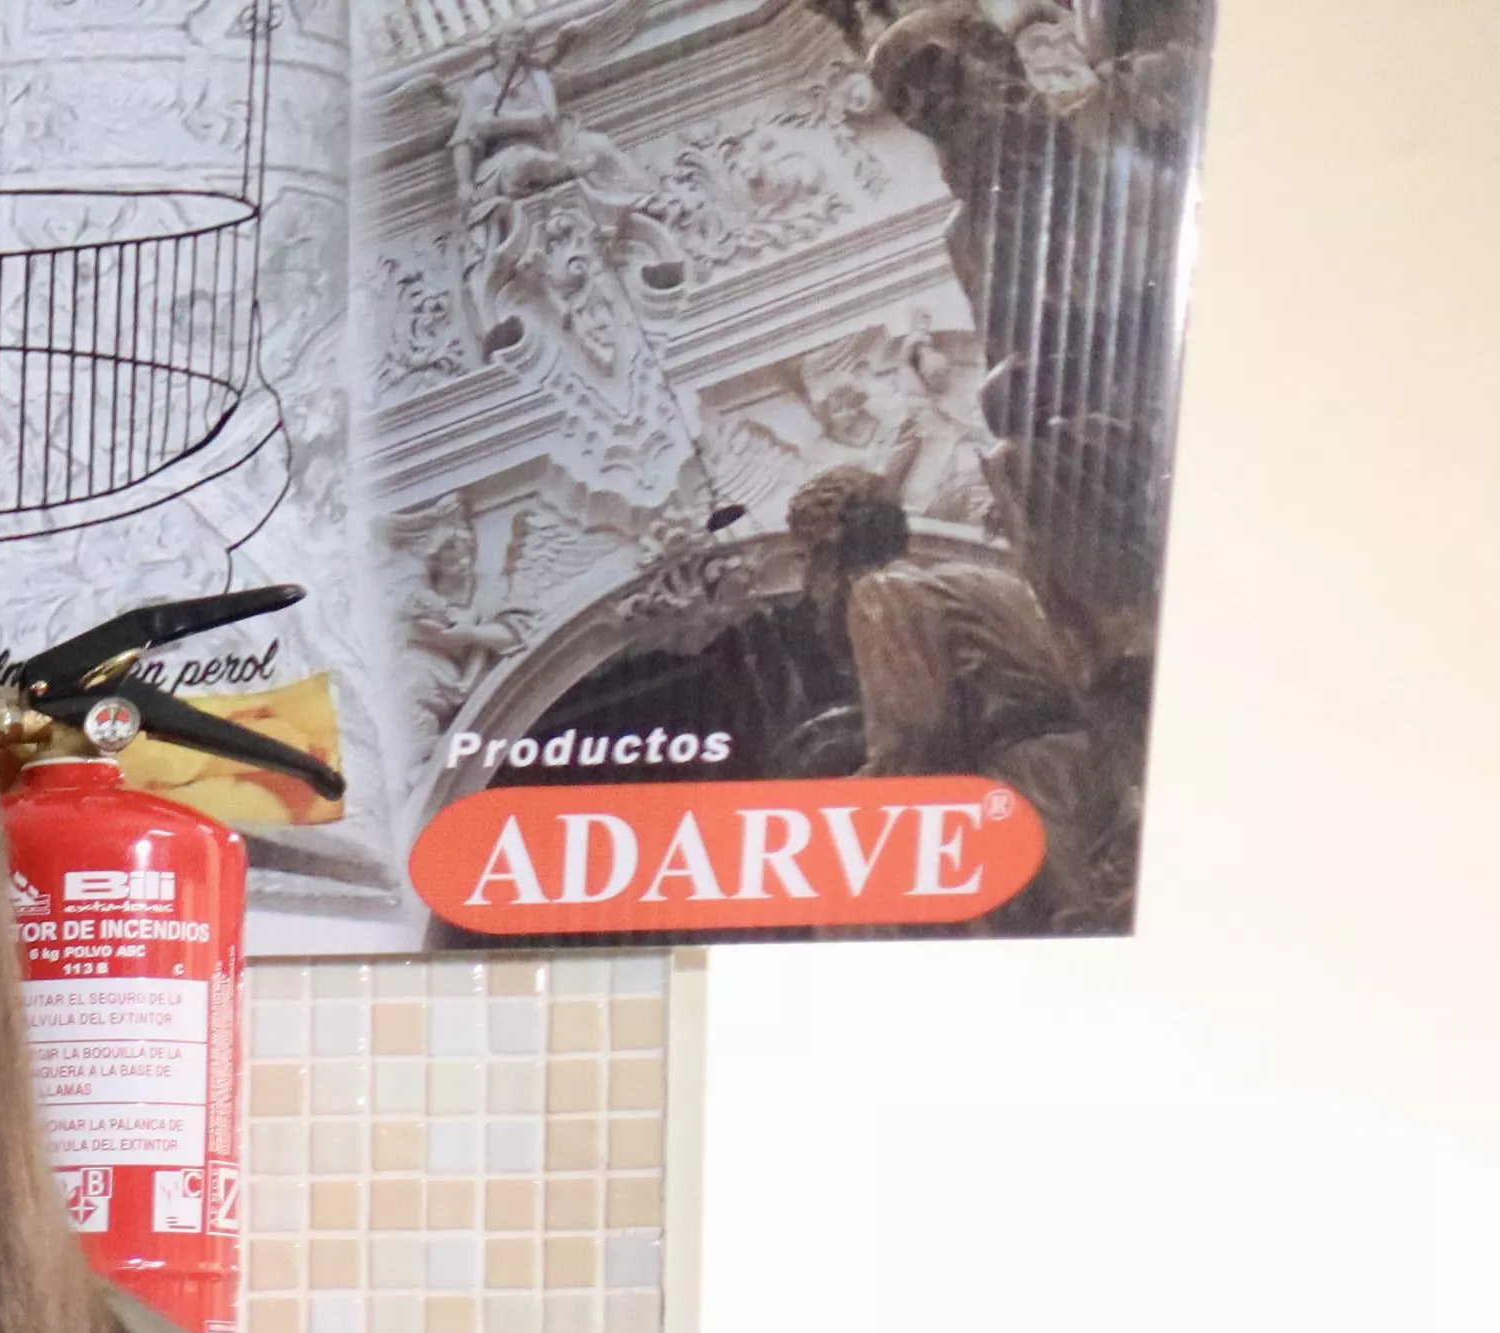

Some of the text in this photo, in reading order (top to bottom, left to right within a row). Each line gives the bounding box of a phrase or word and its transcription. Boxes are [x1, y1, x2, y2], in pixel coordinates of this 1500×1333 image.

[169, 638, 279, 695] perol
[445, 724, 732, 771] Productos
[63, 918, 209, 942] DE INCENDIOS
[63, 945, 112, 958] POLVO
[173, 963, 184, 975] C
[69, 993, 84, 1006] EL
[79, 1012, 105, 1025] DEL
[63, 1047, 80, 1060] LA
[83, 1046, 146, 1060] BOQUILLA
[149, 1046, 167, 1059] DE
[89, 1063, 172, 1077] A LA BASE DE
[89, 1118, 105, 1131] LA
[109, 1118, 165, 1131] PALANCA
[91, 1138, 116, 1151] DEL
[87, 1170, 105, 1195] B
[186, 1171, 203, 1198] C
